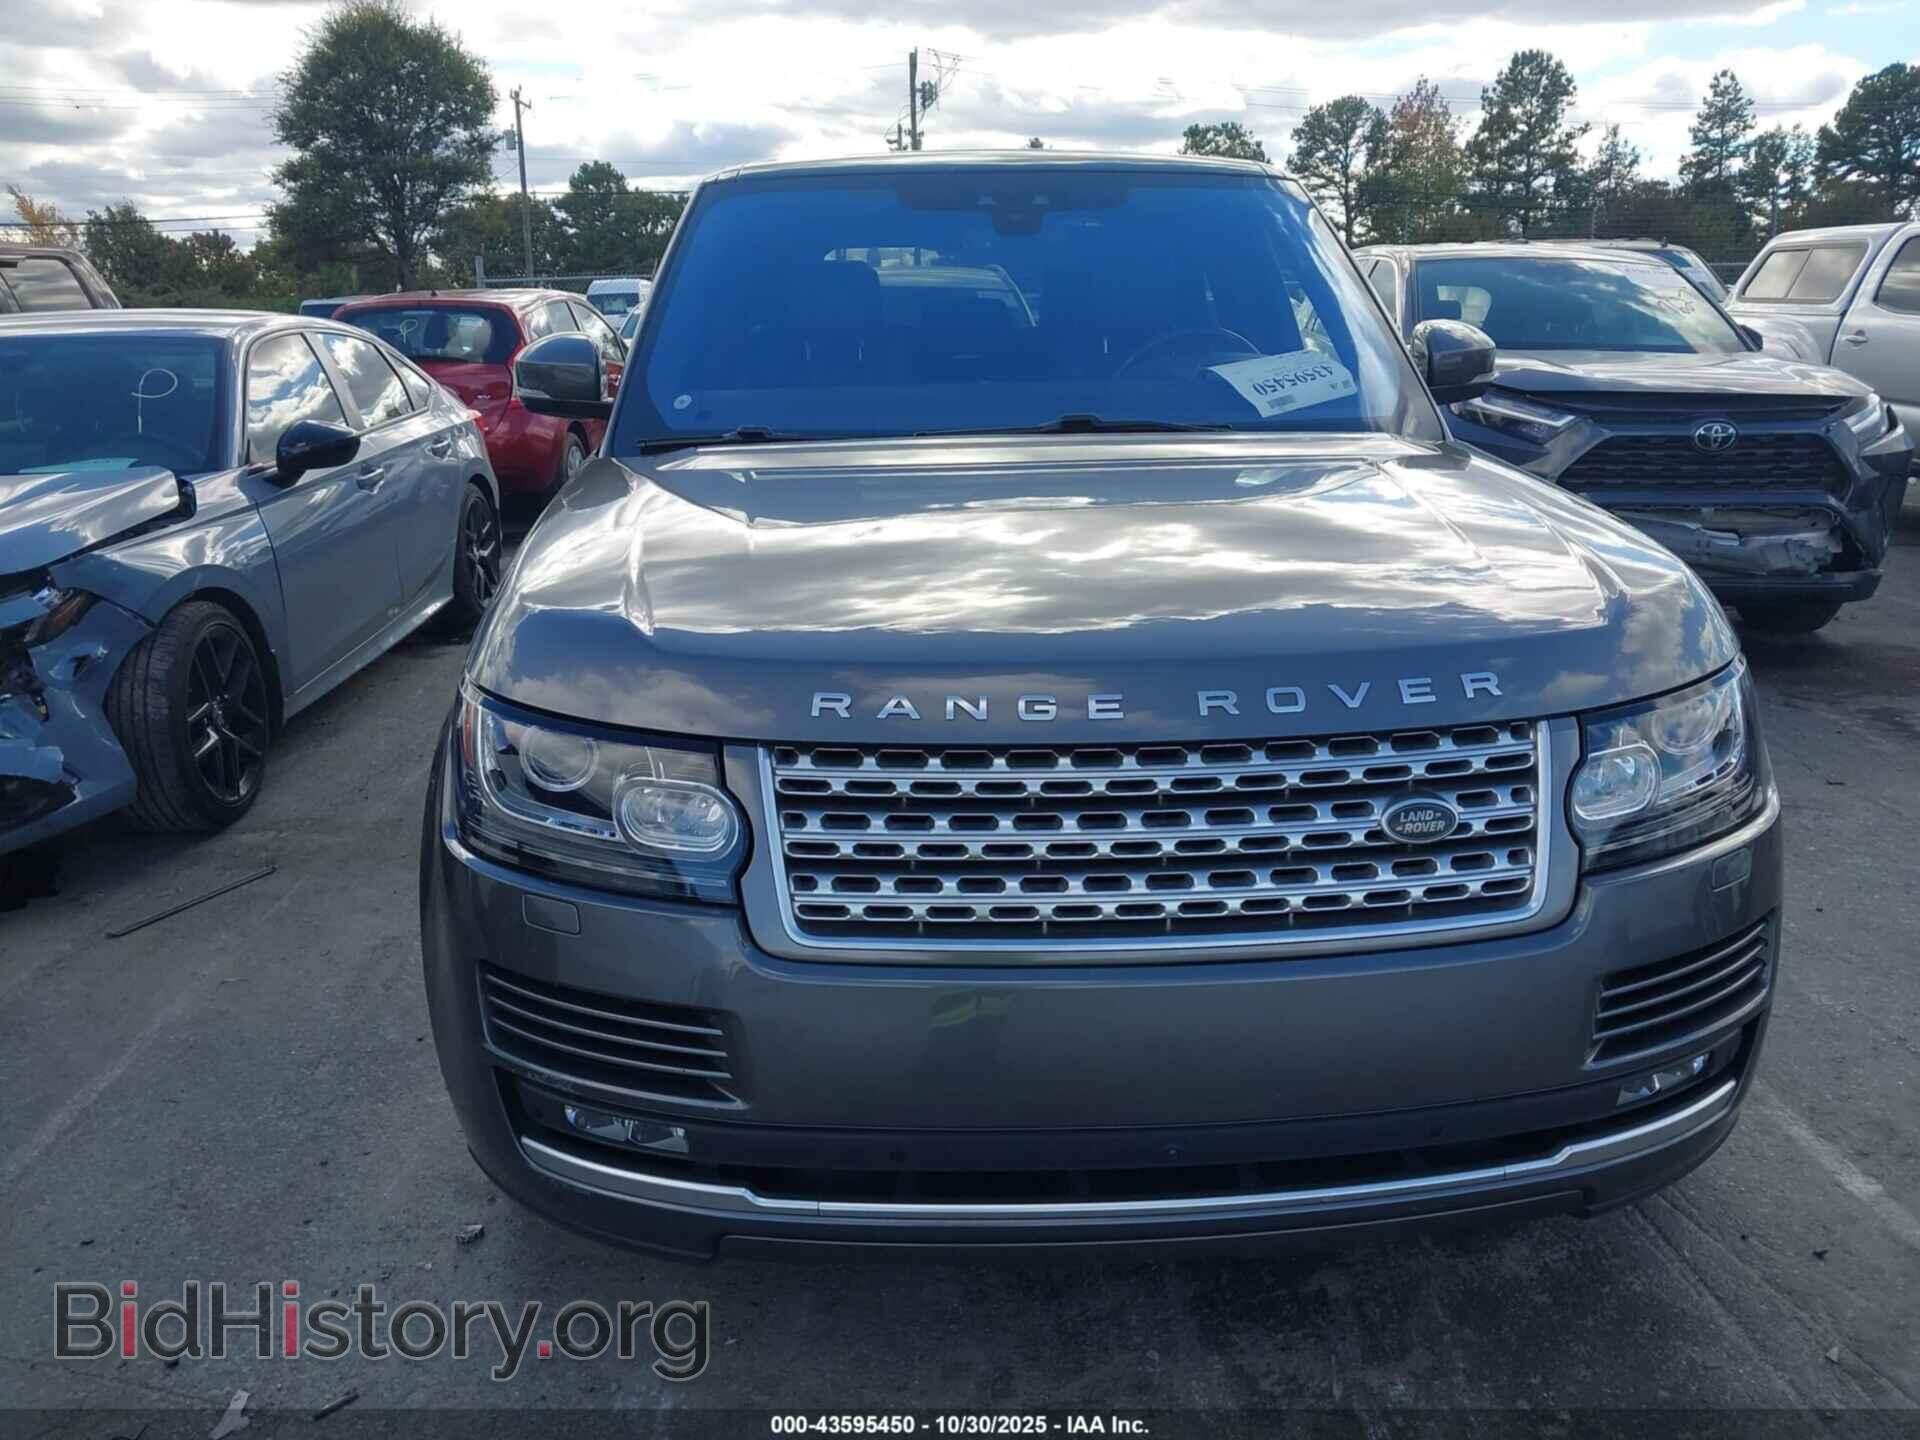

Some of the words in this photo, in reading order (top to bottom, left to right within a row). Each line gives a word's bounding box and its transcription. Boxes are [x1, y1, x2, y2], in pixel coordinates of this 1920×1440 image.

[1252, 364, 1333, 396] 43595450
[810, 692, 1125, 720] RANGE
[1198, 671, 1504, 716] ROVER
